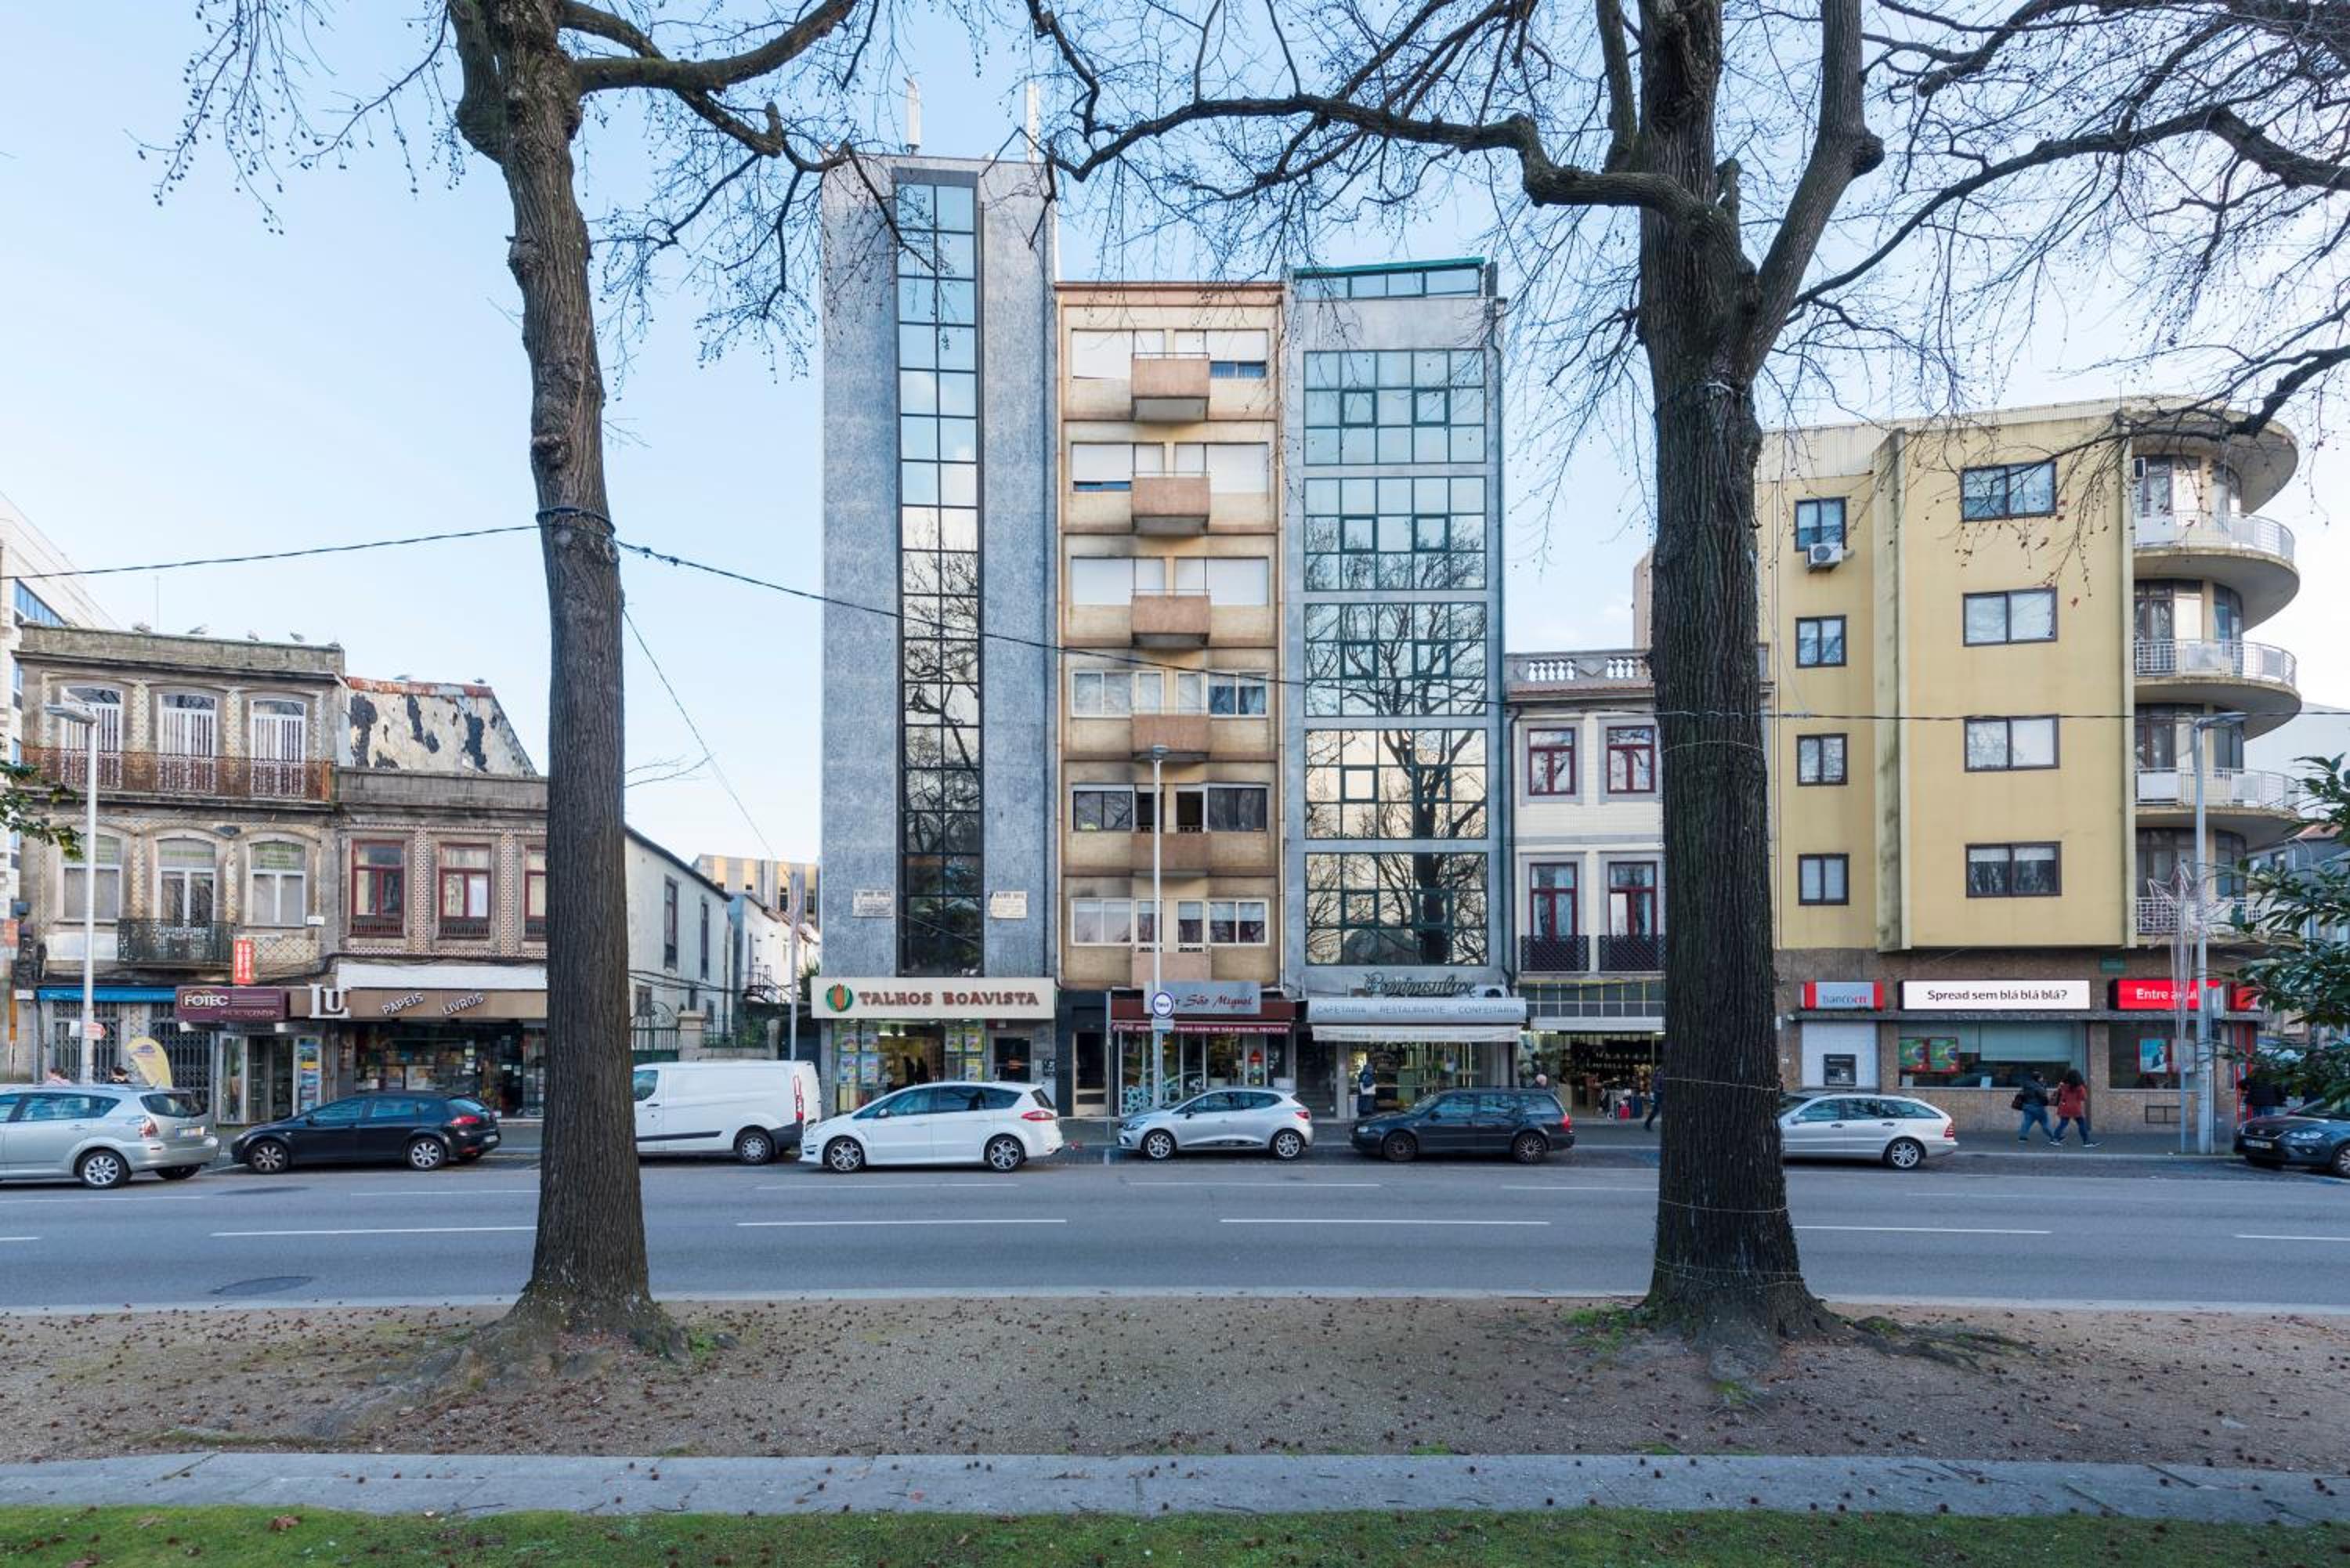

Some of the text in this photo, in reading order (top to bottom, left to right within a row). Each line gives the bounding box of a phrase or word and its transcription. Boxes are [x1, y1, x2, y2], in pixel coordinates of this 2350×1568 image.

[184, 995, 229, 1006] FOTEC
[859, 992, 1039, 1006] TALHOS BOAVISTA
[1928, 989, 2067, 1002] Spread sem blá blá blá?
[2136, 988, 2197, 1002] Entre aui
[381, 992, 425, 1015] PAPEIS
[442, 992, 484, 1015] LIVROS
